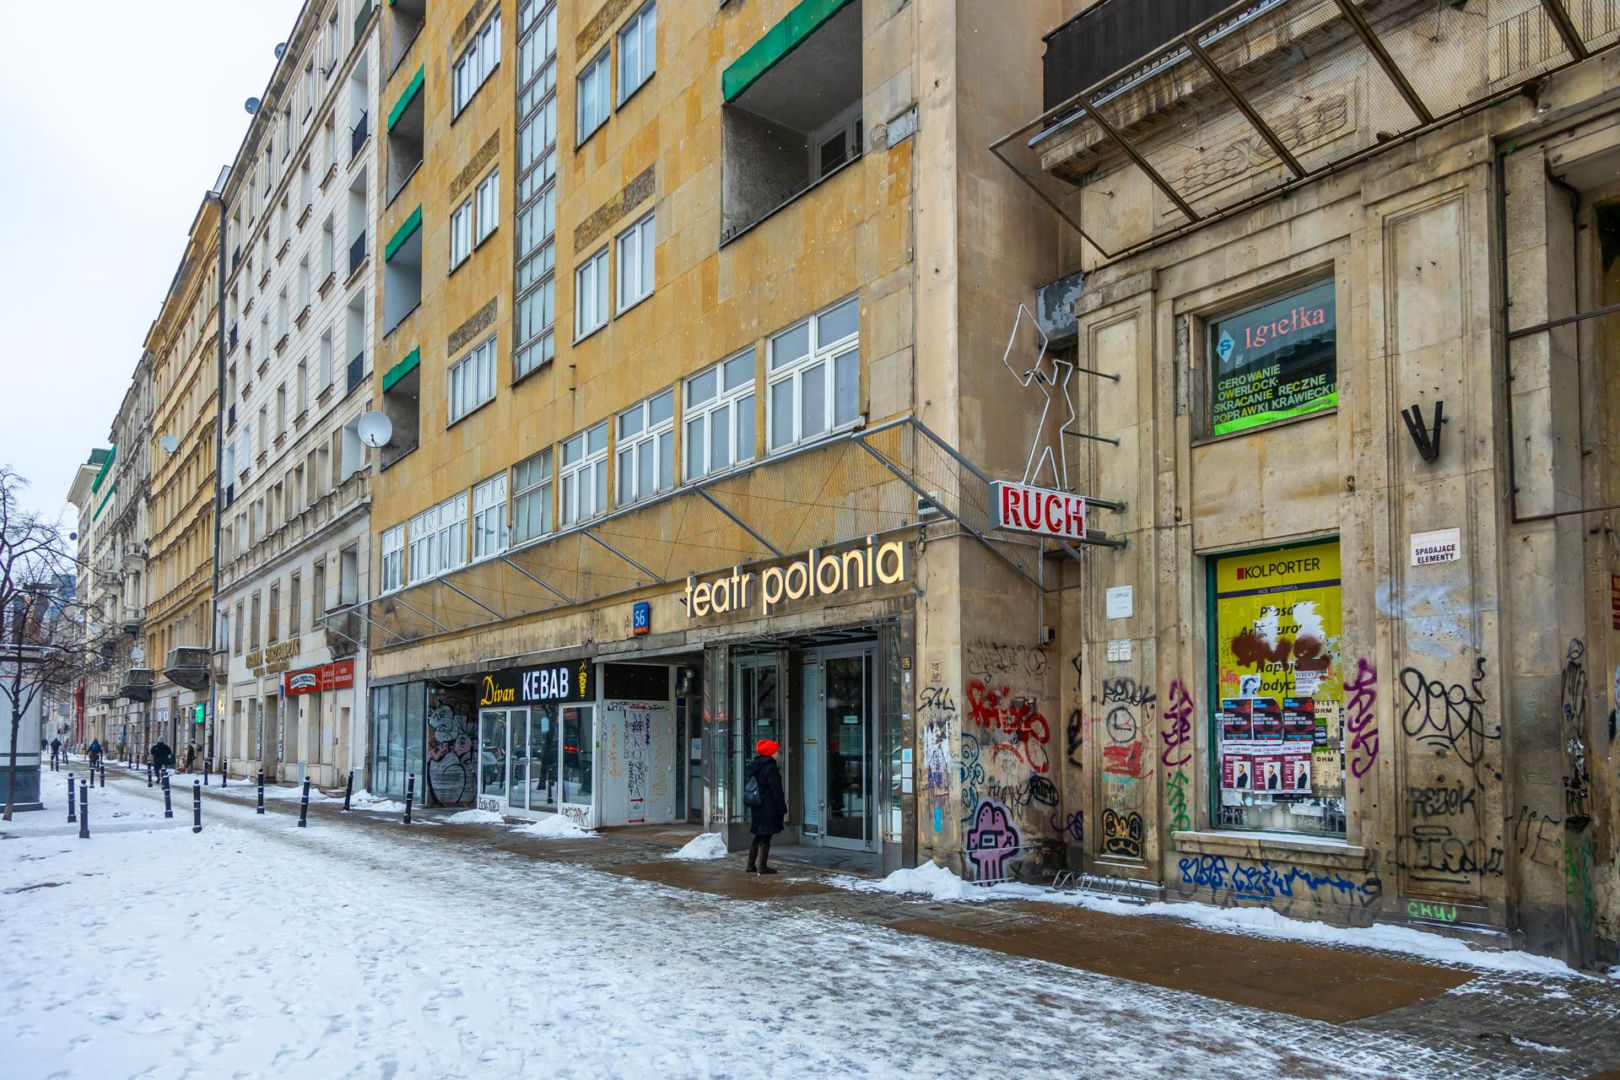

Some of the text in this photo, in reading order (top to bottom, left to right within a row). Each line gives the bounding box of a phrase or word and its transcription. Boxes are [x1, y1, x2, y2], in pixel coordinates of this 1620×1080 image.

[1244, 306, 1325, 350] Igiełka
[1217, 364, 1281, 391] CEROWANIE
[1214, 389, 1273, 413] SKRACANIE
[1278, 374, 1327, 396] RĘCZNE
[1213, 403, 1269, 425] POPRAWKI
[1002, 485, 1084, 537] RUCH
[1415, 543, 1456, 556] SPADAJĄCE
[1417, 553, 1454, 564] ELEMENTY
[685, 535, 907, 618] teatr polonia
[1244, 557, 1321, 579] KOLPORTER
[635, 609, 645, 626] 56
[480, 667, 569, 706] Divan KEBAB
[1407, 902, 1458, 922] CHUJ
